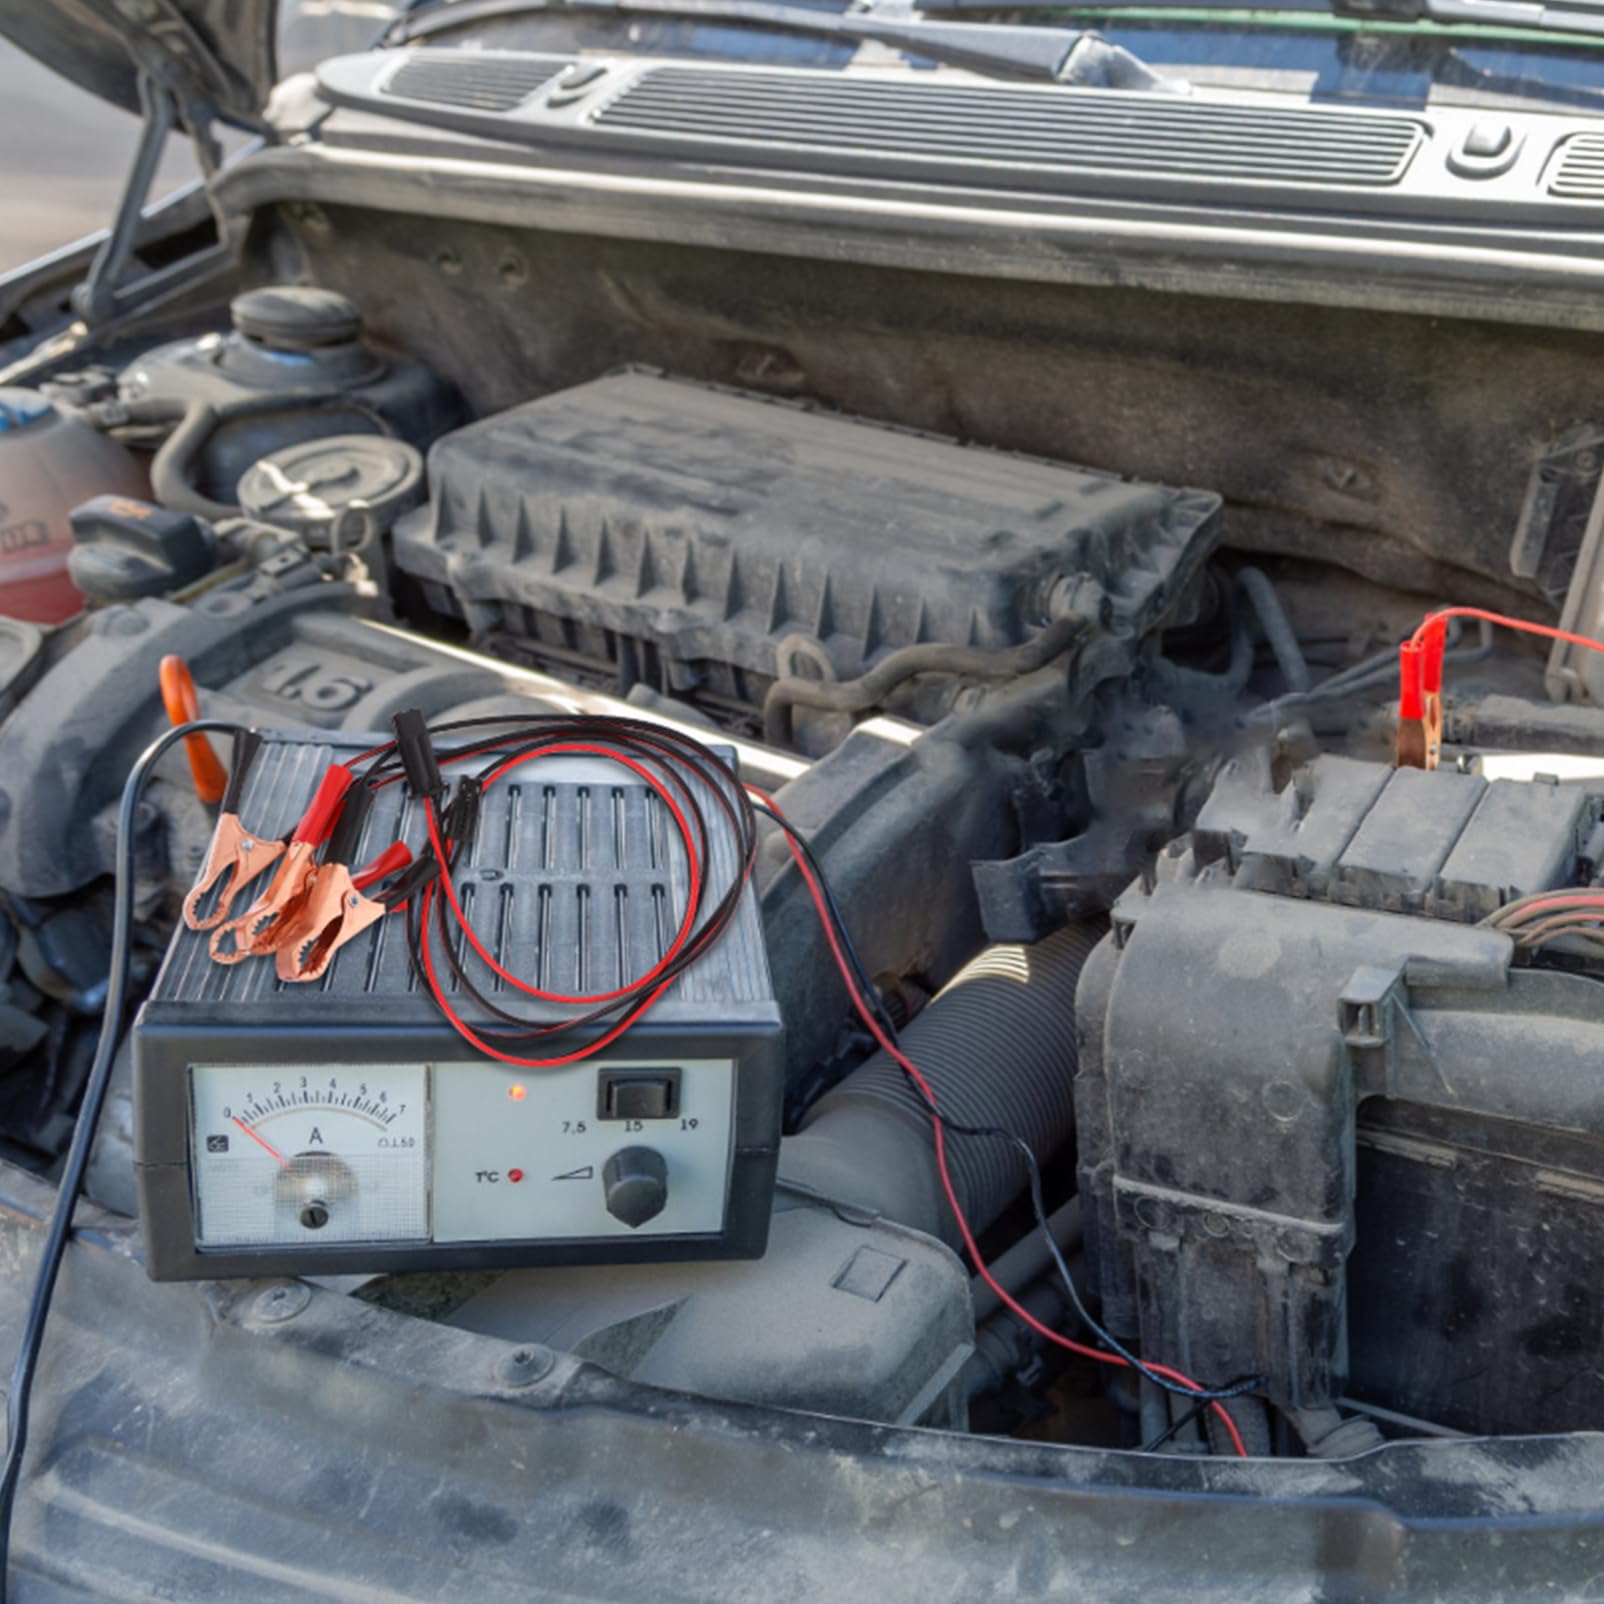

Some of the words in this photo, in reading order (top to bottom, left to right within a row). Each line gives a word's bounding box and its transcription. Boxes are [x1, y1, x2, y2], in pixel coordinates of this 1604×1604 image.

[262, 663, 374, 713] 1.6
[223, 1106, 232, 1119] 0
[273, 1081, 281, 1094] 2
[300, 1075, 307, 1089] 3
[329, 1077, 337, 1090] 4
[360, 1083, 368, 1096] 5
[379, 1090, 387, 1104] 6
[308, 1126, 324, 1144] A
[624, 1120, 643, 1133] 15
[680, 1118, 699, 1131] 19
